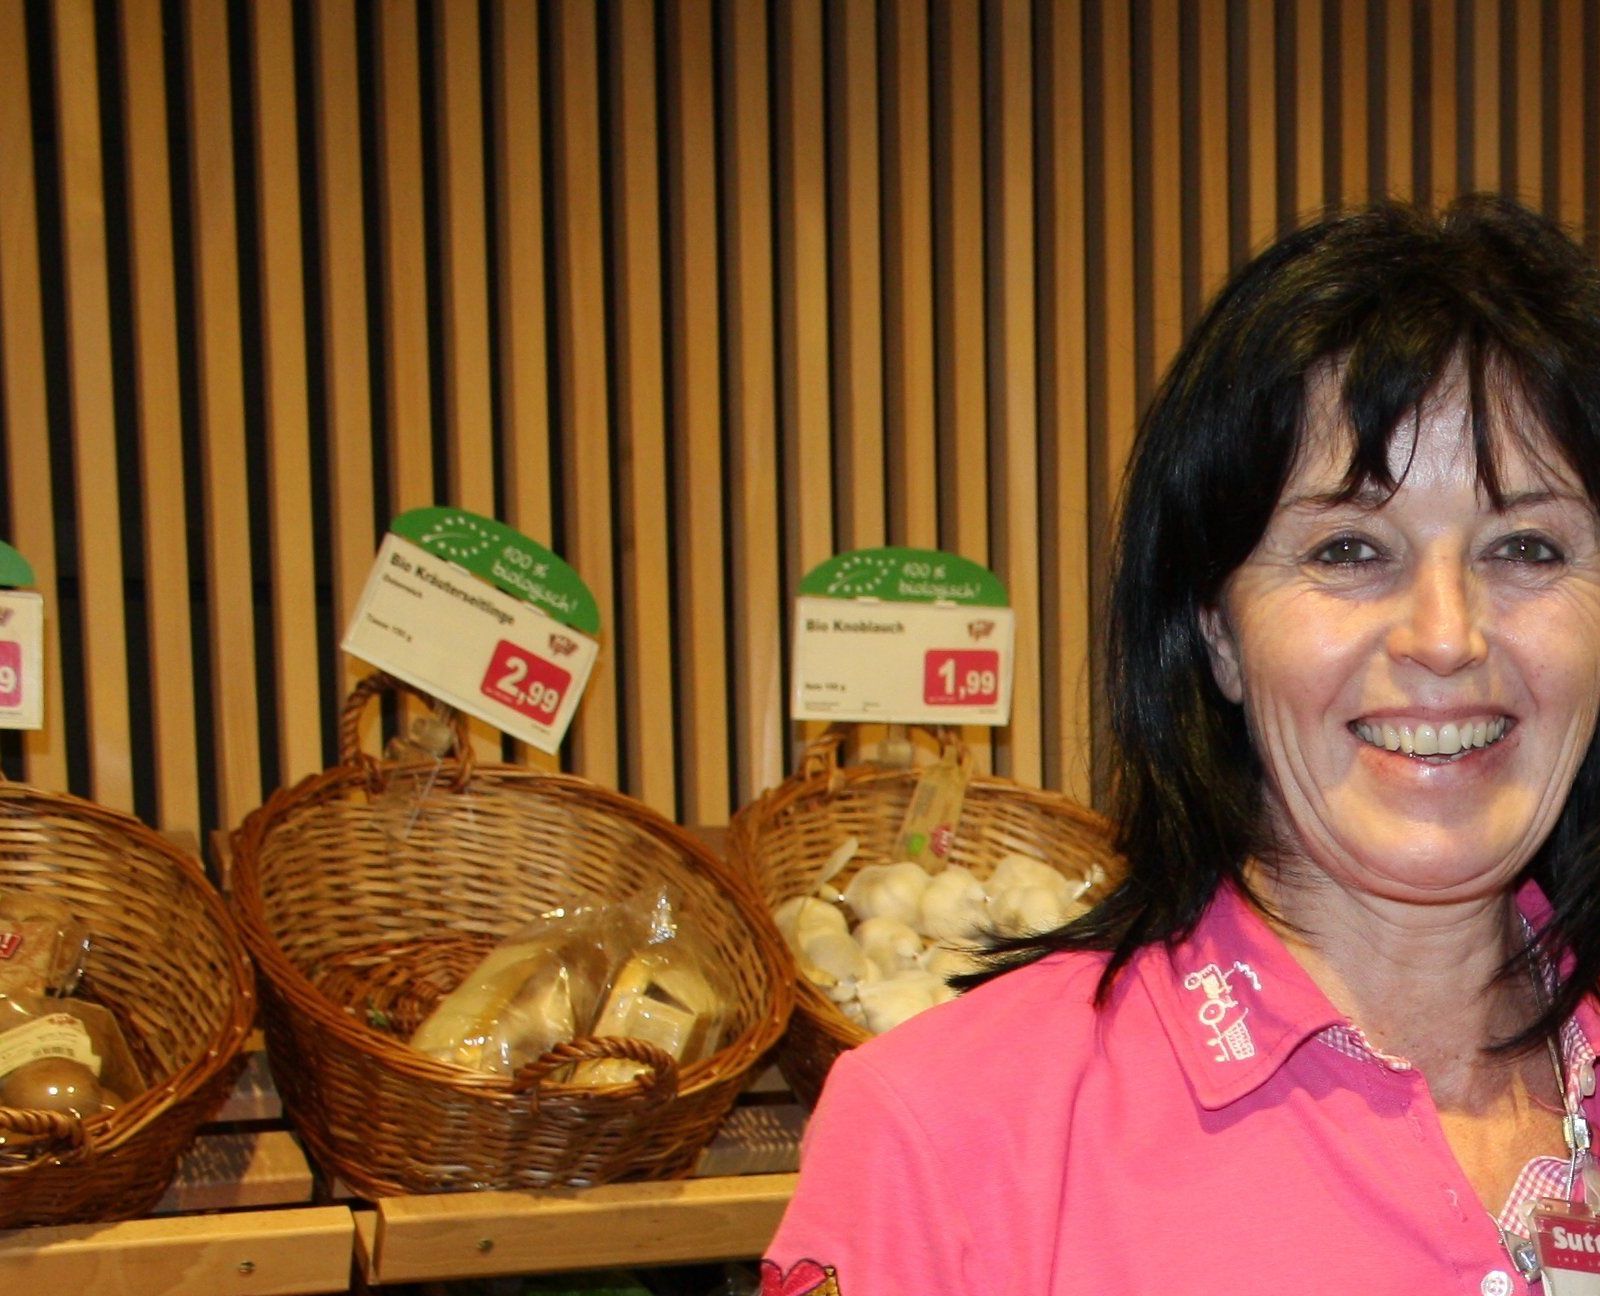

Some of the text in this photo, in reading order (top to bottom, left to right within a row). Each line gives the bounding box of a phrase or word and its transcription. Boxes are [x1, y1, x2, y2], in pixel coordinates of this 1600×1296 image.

[805, 618, 905, 635] Bio Knoblauch
[496, 655, 561, 716] 2,99
[937, 658, 996, 701] 1,99
